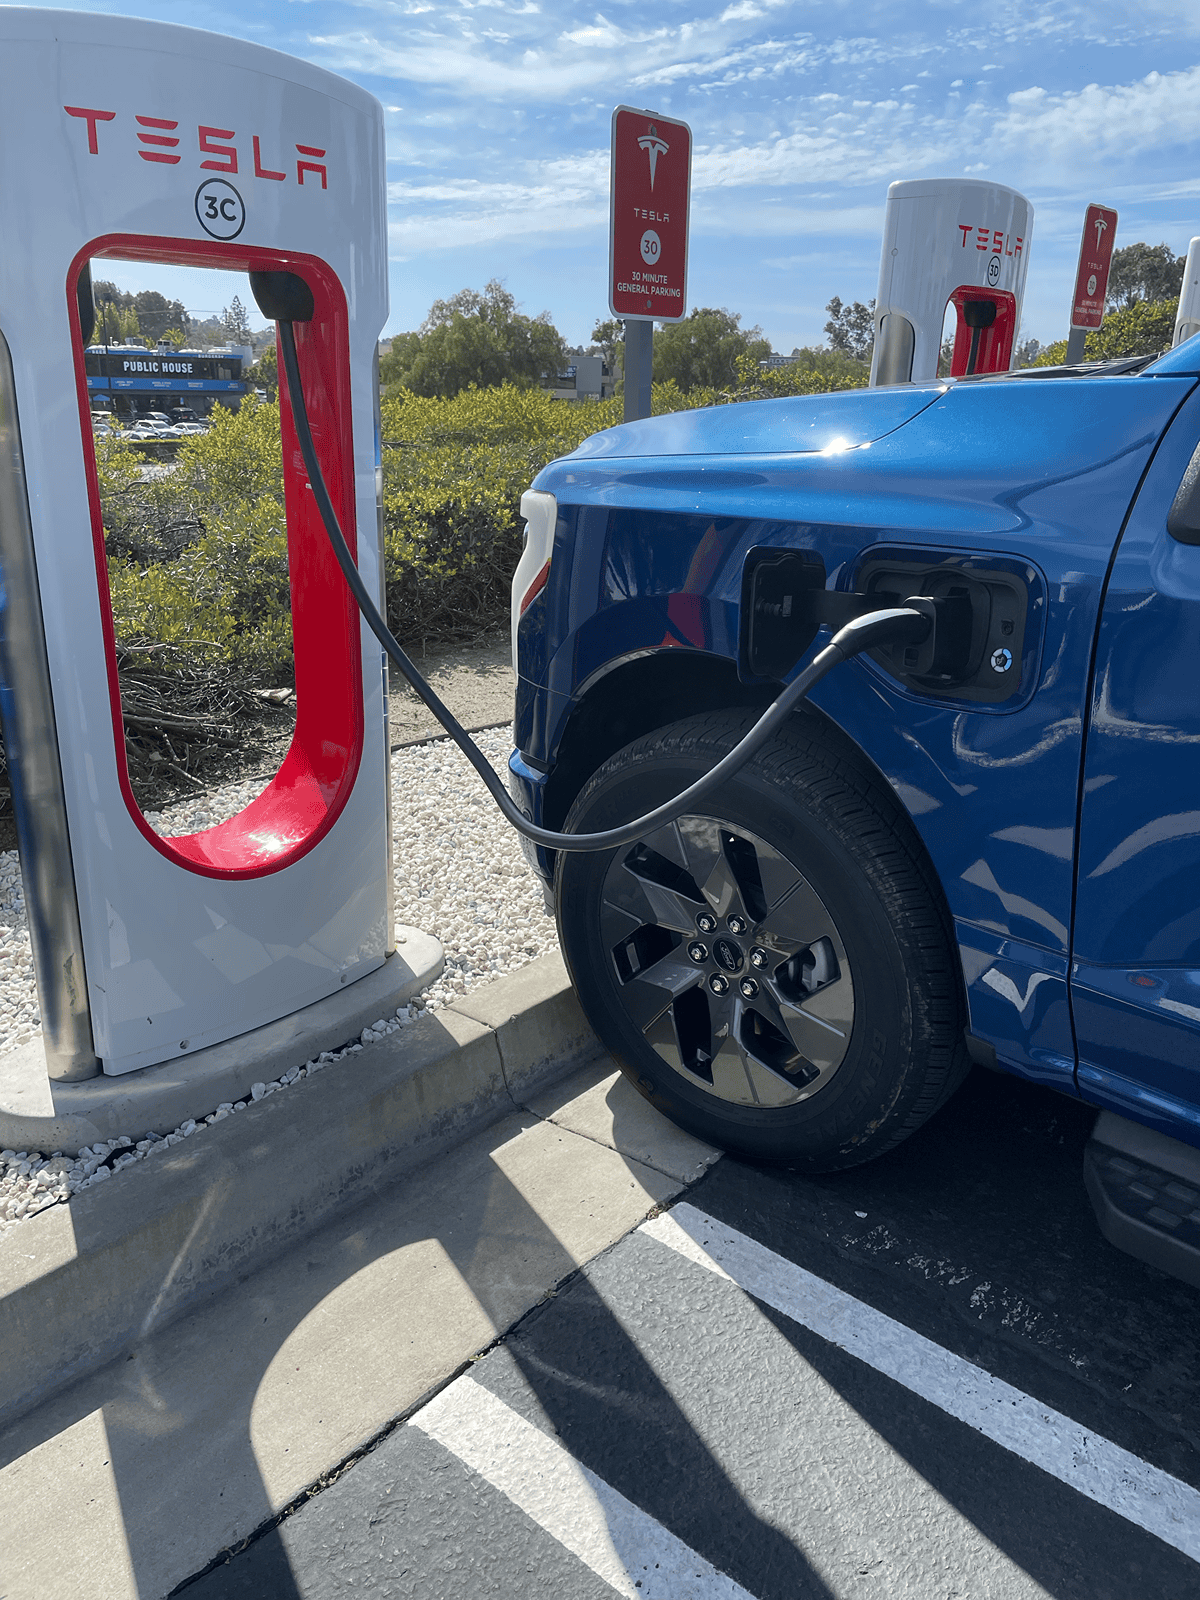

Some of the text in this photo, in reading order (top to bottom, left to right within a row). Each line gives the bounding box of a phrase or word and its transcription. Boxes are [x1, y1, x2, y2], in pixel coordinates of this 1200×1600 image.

[63, 105, 328, 190] TESLA
[203, 195, 237, 222] 3C
[634, 208, 670, 222] TESLA
[643, 239, 658, 255] 30
[958, 224, 1023, 258] TESLA
[631, 271, 668, 284] 30 MINUTE
[989, 264, 999, 277] 3D
[617, 283, 681, 297] GENERAL PARKING
[123, 361, 194, 374] PUBLIC HOUSE
